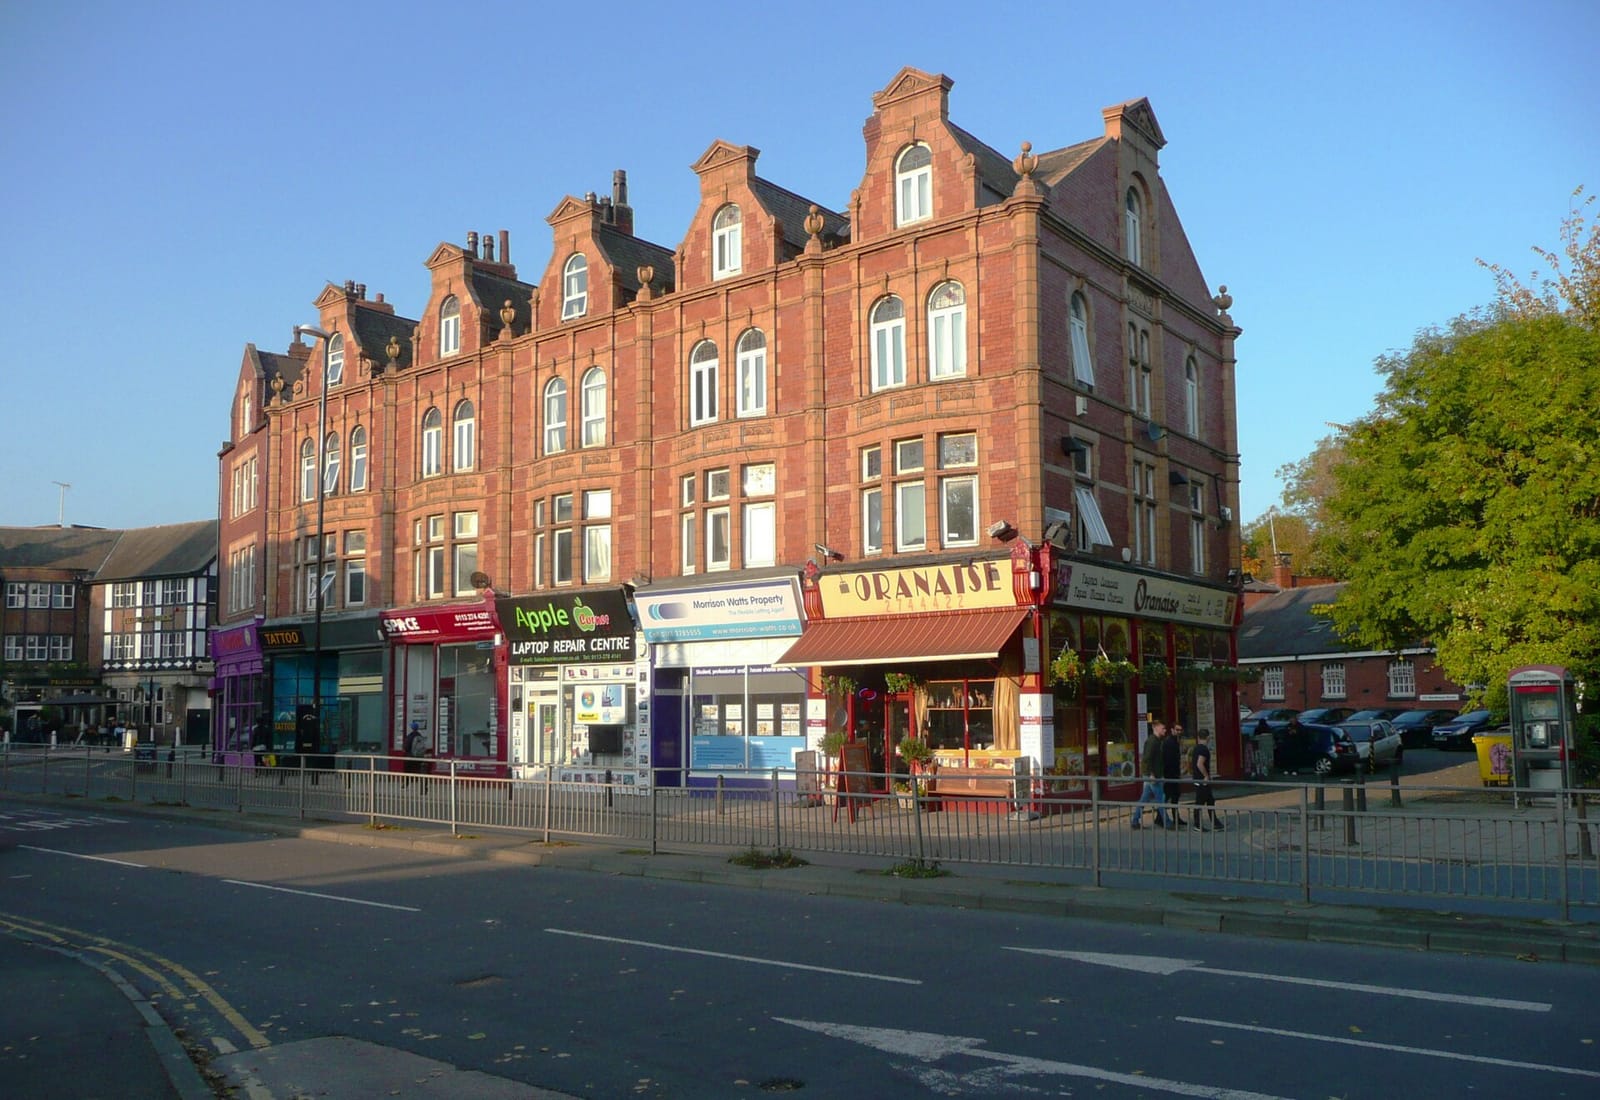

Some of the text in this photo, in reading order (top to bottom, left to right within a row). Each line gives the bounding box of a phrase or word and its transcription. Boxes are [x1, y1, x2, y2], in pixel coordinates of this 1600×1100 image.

[855, 562, 1002, 602] ORANAISE
[693, 594, 784, 610] Morrison Watts Property
[1134, 578, 1180, 614] Oranaise
[515, 603, 570, 633] Apple
[264, 632, 299, 645] TATTOO
[512, 641, 549, 655] LAPTOP
[553, 639, 586, 653] REPAIR
[590, 637, 632, 651] CENTRE
